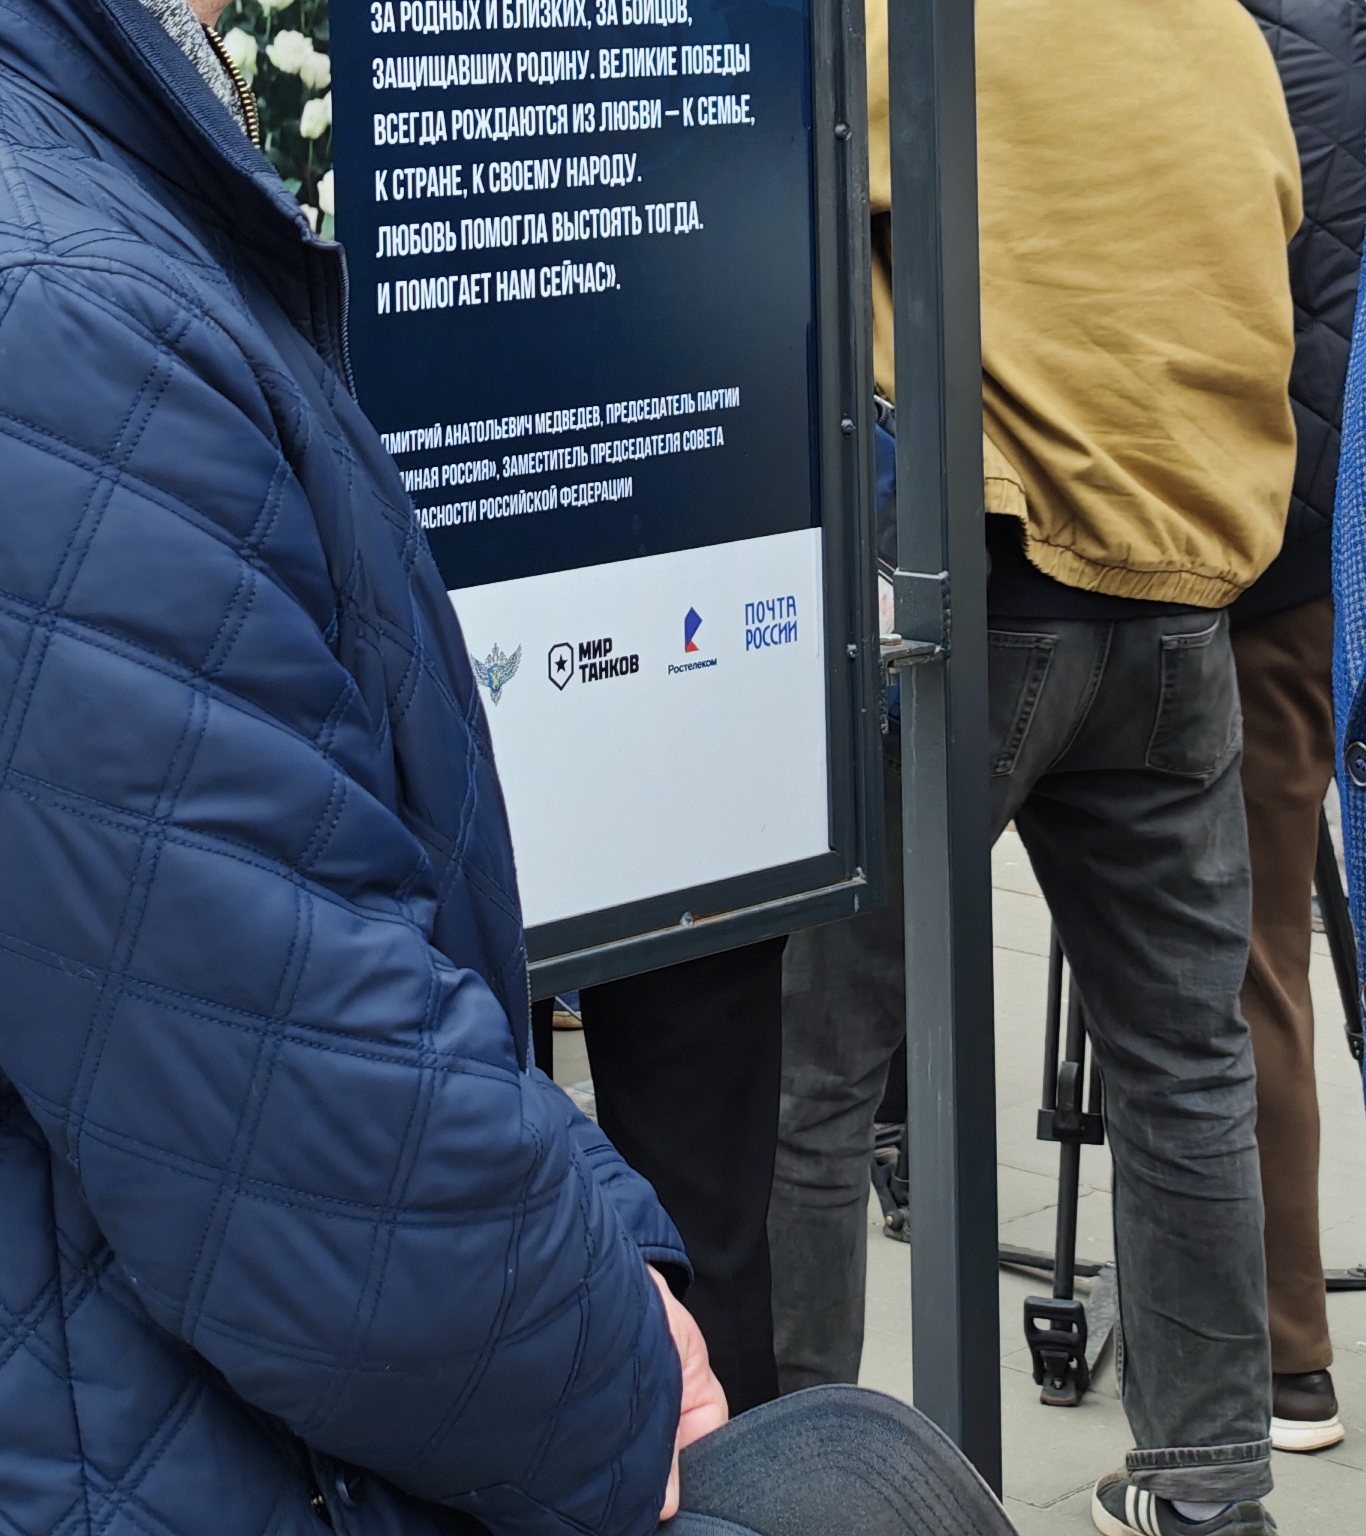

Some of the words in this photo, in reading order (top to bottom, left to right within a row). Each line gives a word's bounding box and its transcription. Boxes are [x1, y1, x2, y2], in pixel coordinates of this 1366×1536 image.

[371, 2, 395, 33] ЗА
[400, 0, 481, 34] РОДНЫХ
[486, 0, 497, 29] И
[373, 53, 512, 90] ЗАЩИЩАВШИХ
[517, 50, 595, 85] РОДИНУ.
[599, 46, 677, 78] ВЕЛИКИЕ
[682, 44, 750, 76] ПОБЕДЫ
[374, 111, 447, 145] ВСЕГДА
[452, 104, 568, 141] РОЖДАЮТСЯ
[573, 103, 595, 133] ИЗ
[599, 99, 661, 131] ЛЮБВИ
[683, 97, 694, 126] К
[698, 95, 755, 125] СЕМЬЕ,
[376, 170, 388, 201] К
[393, 165, 467, 200] СТРАНЕ,
[473, 163, 484, 194] К
[489, 158, 561, 193] СВОЕМУ
[567, 153, 641, 187] НАРОДУ.
[376, 221, 456, 258] ЛЮБОВЬ
[461, 213, 548, 250] ПОМОГЛА
[552, 206, 642, 242] ВЫСТОЯТЬ
[645, 201, 703, 234] ТОГДА.
[378, 282, 390, 314] И
[396, 273, 491, 312] ПОМОГАЕТ
[497, 269, 535, 302] НАМ
[540, 260, 620, 297] СЕЙЧАС».
[445, 415, 532, 446] АНАТОЛЬЕВИЧ
[535, 406, 603, 434] МЕДВЕДЕВ,
[606, 394, 695, 424] ПРЕДСЕДАТЕЛЬ
[698, 387, 739, 411] ПАРТИИ
[442, 459, 499, 486] РОССИЯ»,
[503, 446, 588, 477] ЗАМЕСТИТЕЛЬ
[591, 432, 680, 464] ПРЕДСЕДАТЕЛЯ
[683, 426, 724, 451] СОВЕТА
[480, 485, 557, 520] РОССИЙСКОЙ
[560, 477, 632, 507] ФЕДЕРАЦИИ
[744, 595, 798, 626] ПОЧТА
[578, 637, 613, 662] МИР
[745, 619, 798, 651] РОССИИ
[579, 653, 640, 683] ТАНКОВ
[667, 658, 718, 675] Ростелеком
